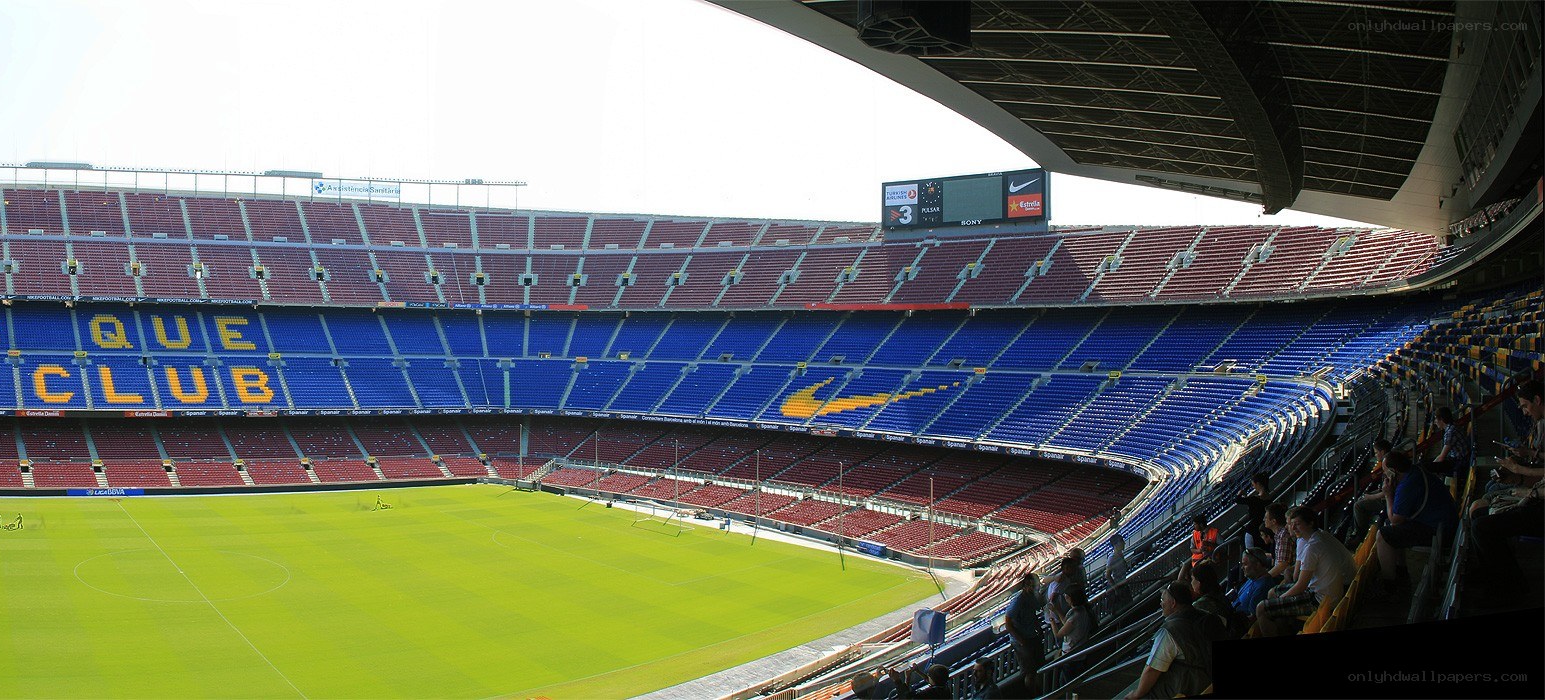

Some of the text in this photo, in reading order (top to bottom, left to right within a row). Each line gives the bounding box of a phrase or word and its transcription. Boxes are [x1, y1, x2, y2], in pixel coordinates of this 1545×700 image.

[899, 206, 912, 224] 3
[89, 314, 256, 350] QUE
[31, 364, 274, 404] CLUB
[1011, 448, 1031, 456] Spanair
[1044, 451, 1064, 459] Spanair
[1076, 455, 1097, 464] Spanair
[1109, 461, 1126, 469] Spanair
